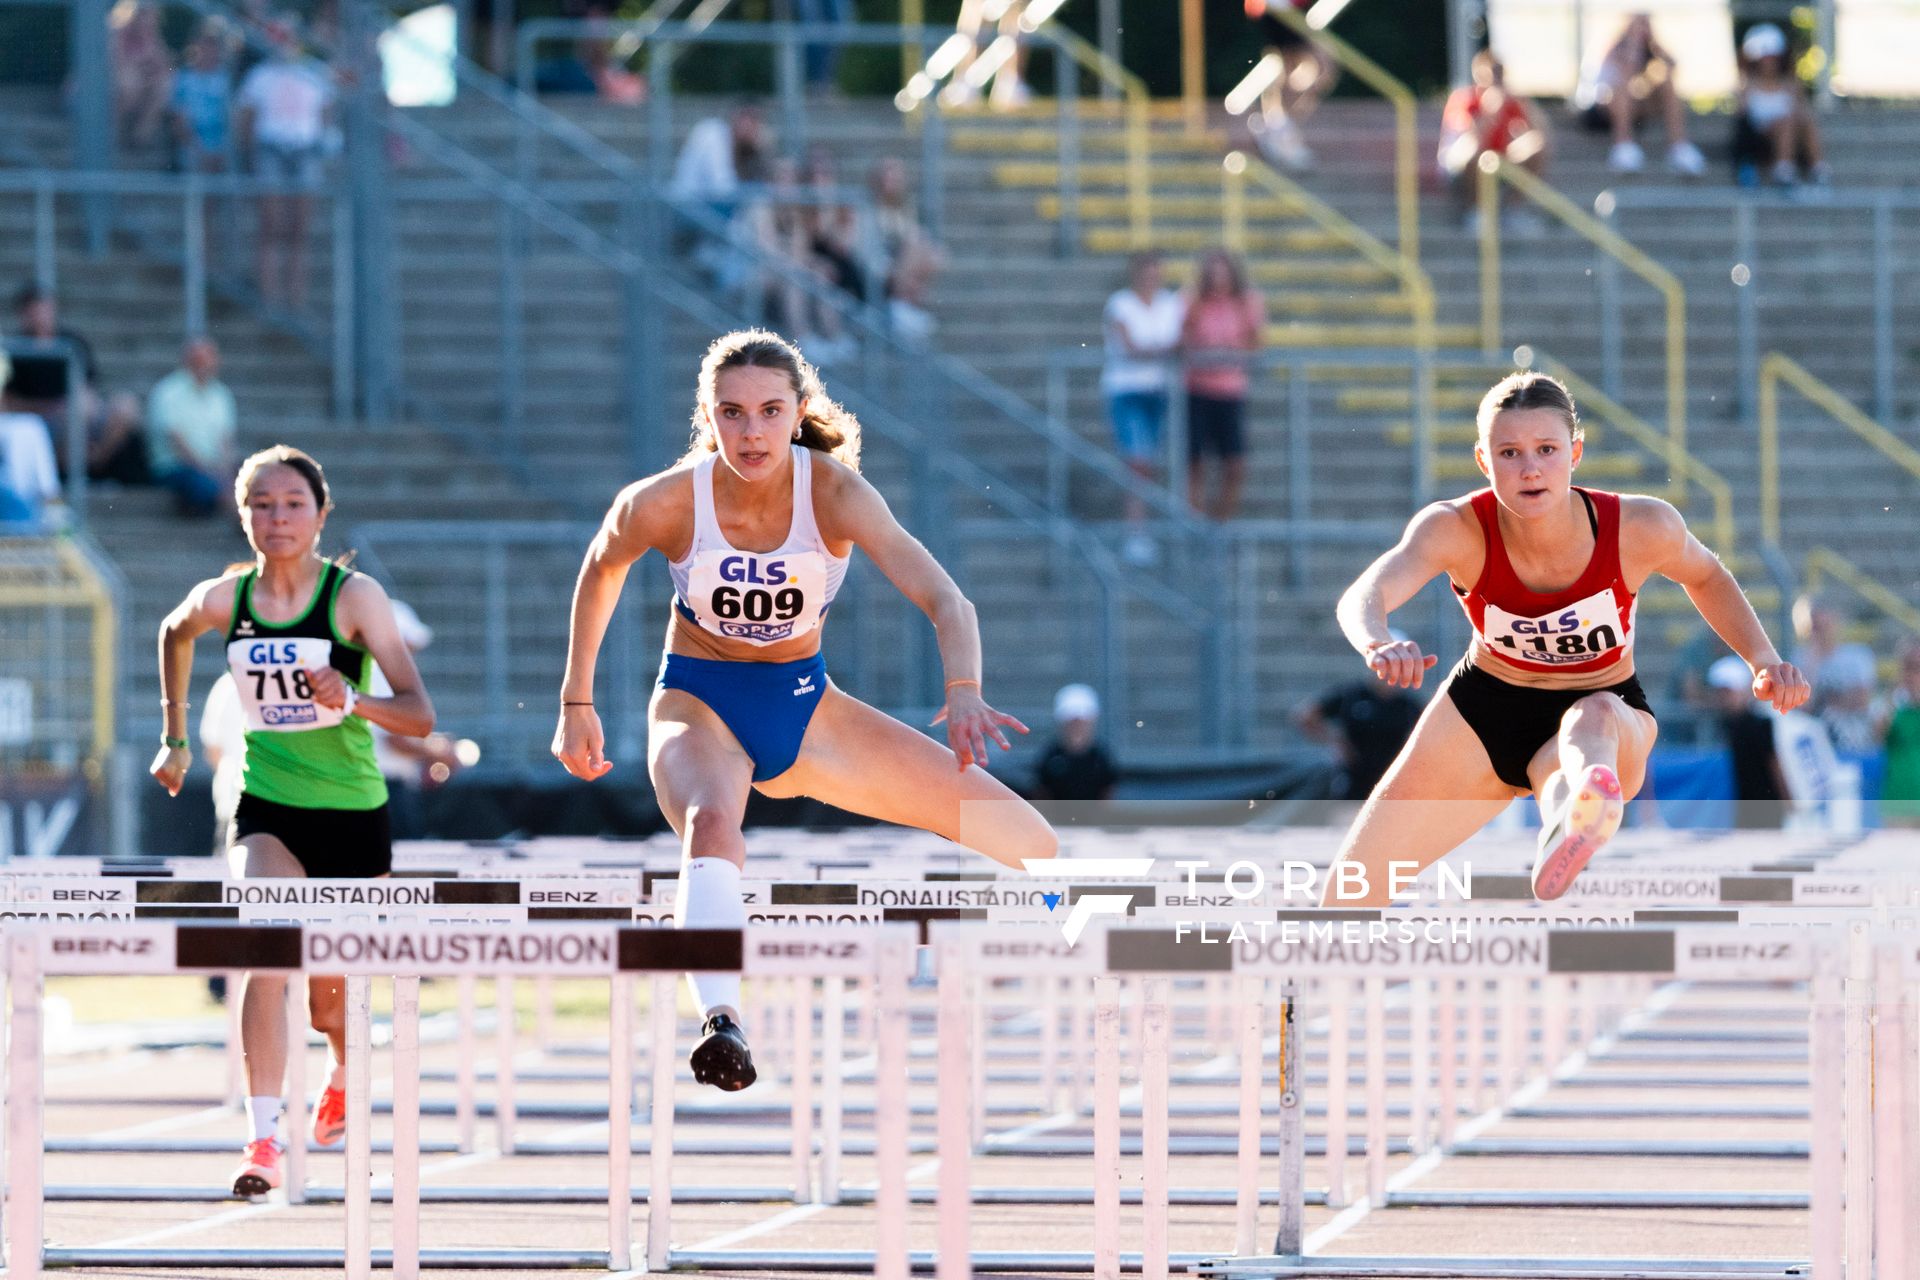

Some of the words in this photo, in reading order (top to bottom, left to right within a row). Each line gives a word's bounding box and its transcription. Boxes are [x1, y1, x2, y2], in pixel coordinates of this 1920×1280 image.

[711, 586, 804, 621] 609
[751, 624, 791, 635] PLAN
[1494, 624, 1617, 654] 1180
[246, 668, 314, 700] 718
[793, 684, 815, 696] erima
[53, 890, 121, 900] BENZ
[226, 886, 432, 904] DONAUSTADION
[530, 891, 598, 902] BENZ
[53, 938, 153, 955] BENZ
[308, 934, 610, 963] DONAUSTADION
[758, 943, 859, 957] BENZ
[1240, 936, 1541, 965] DONAUSTADION
[1690, 944, 1792, 958] BENZ
